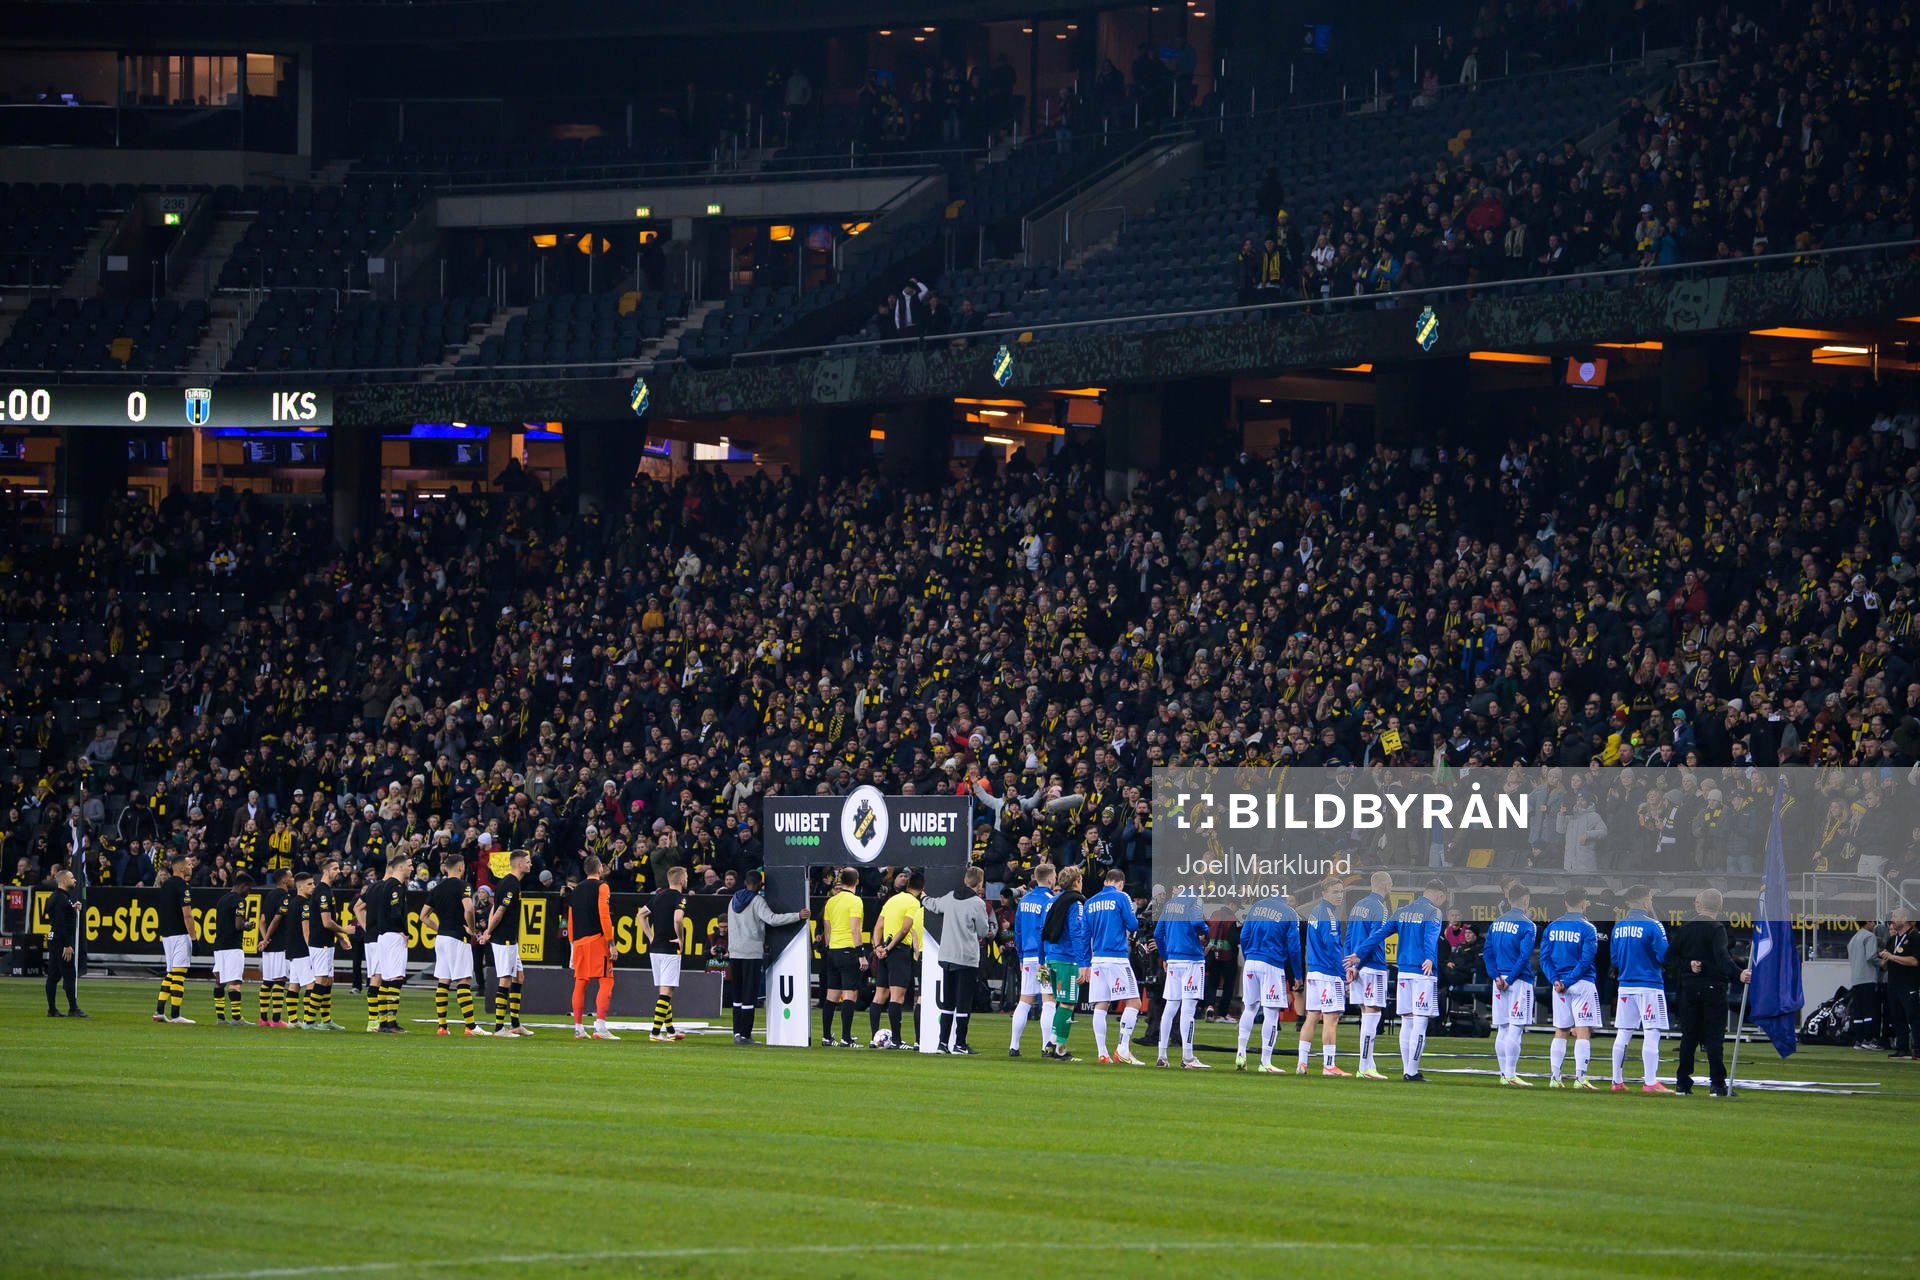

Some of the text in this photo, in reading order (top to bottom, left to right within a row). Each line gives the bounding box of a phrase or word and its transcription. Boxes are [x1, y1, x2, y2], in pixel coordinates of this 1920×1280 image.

[127, 391, 147, 422] 0
[272, 392, 317, 421] IKS
[774, 813, 830, 832] UNIBET
[900, 813, 957, 833] UNIBET
[1088, 900, 1116, 914] SIRIUS
[1253, 906, 1283, 923] SIRIUS
[1492, 921, 1519, 935] SIRIUS
[1549, 930, 1580, 943] SIRIUS
[1614, 926, 1643, 939] SIRIUS
[522, 944, 540, 954] STEN
[780, 975, 793, 1004] U
